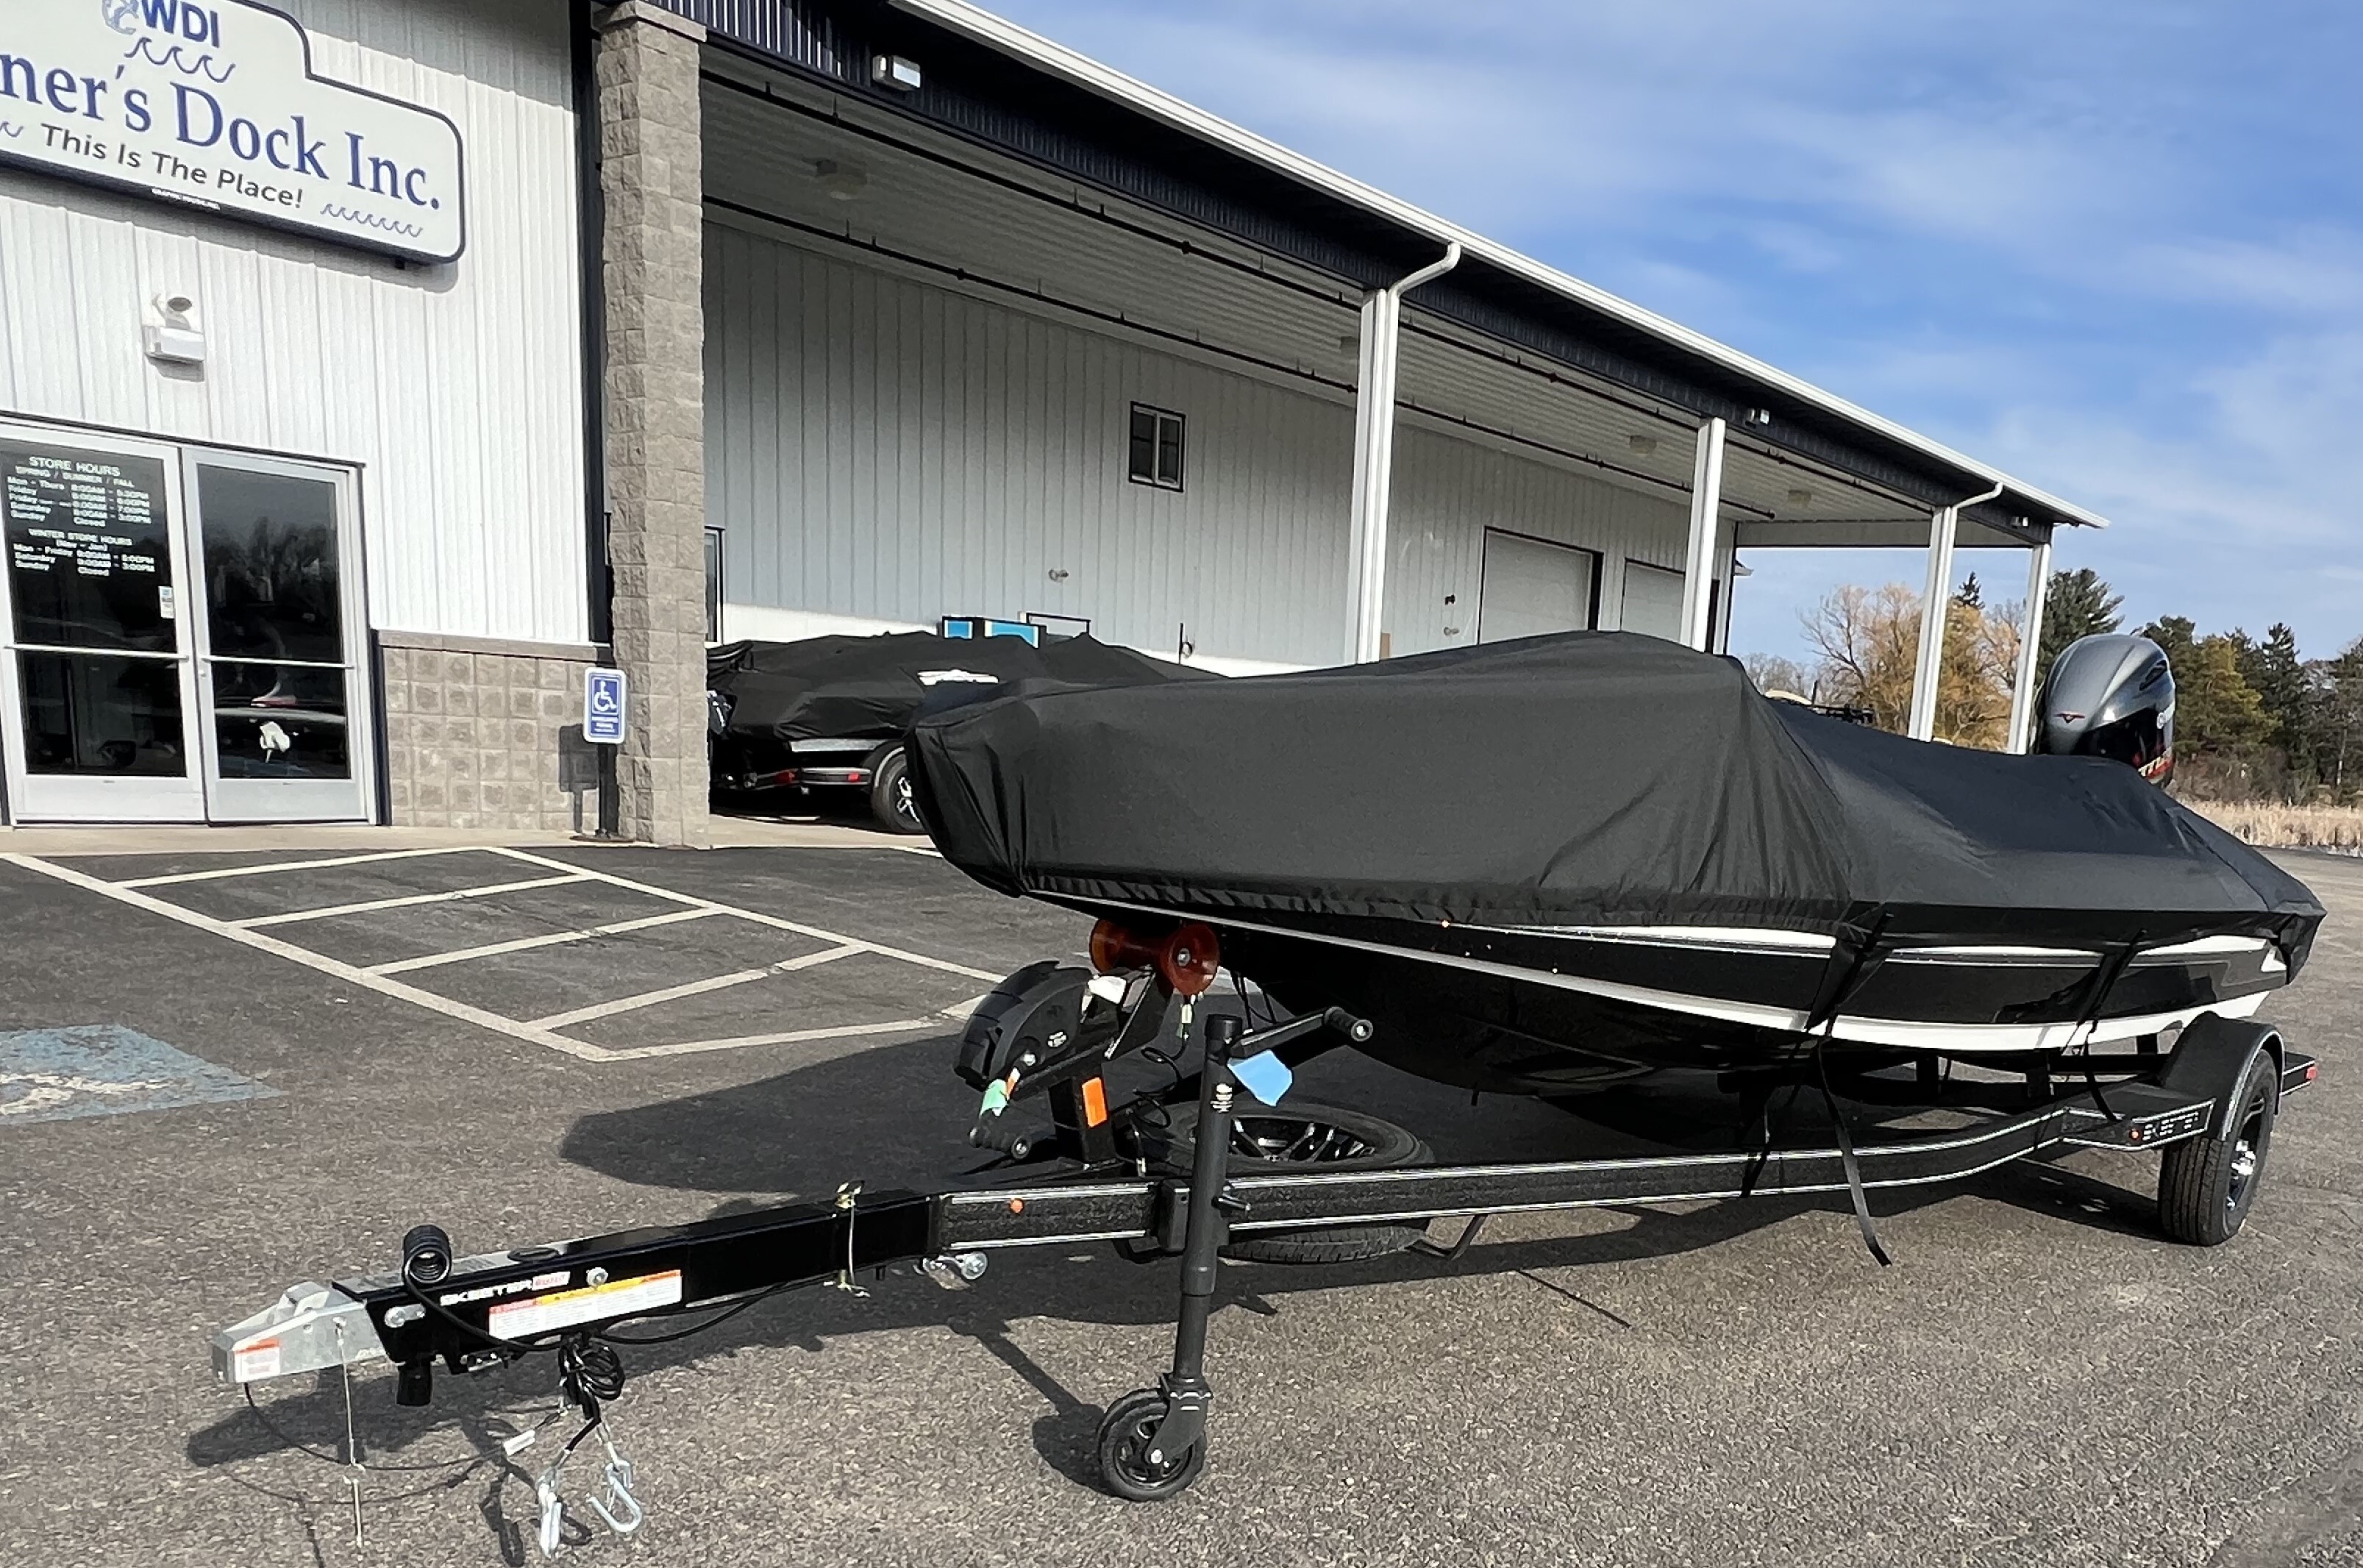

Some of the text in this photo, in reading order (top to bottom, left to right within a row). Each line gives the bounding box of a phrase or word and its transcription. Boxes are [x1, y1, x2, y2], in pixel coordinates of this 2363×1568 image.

[141, 0, 219, 48] WDI
[0, 54, 440, 210] ner's Dock Inc.
[40, 123, 107, 160] This
[118, 143, 142, 168] Is
[152, 151, 207, 184] The
[217, 168, 304, 209] Place!
[29, 456, 121, 477] STORE HOURS
